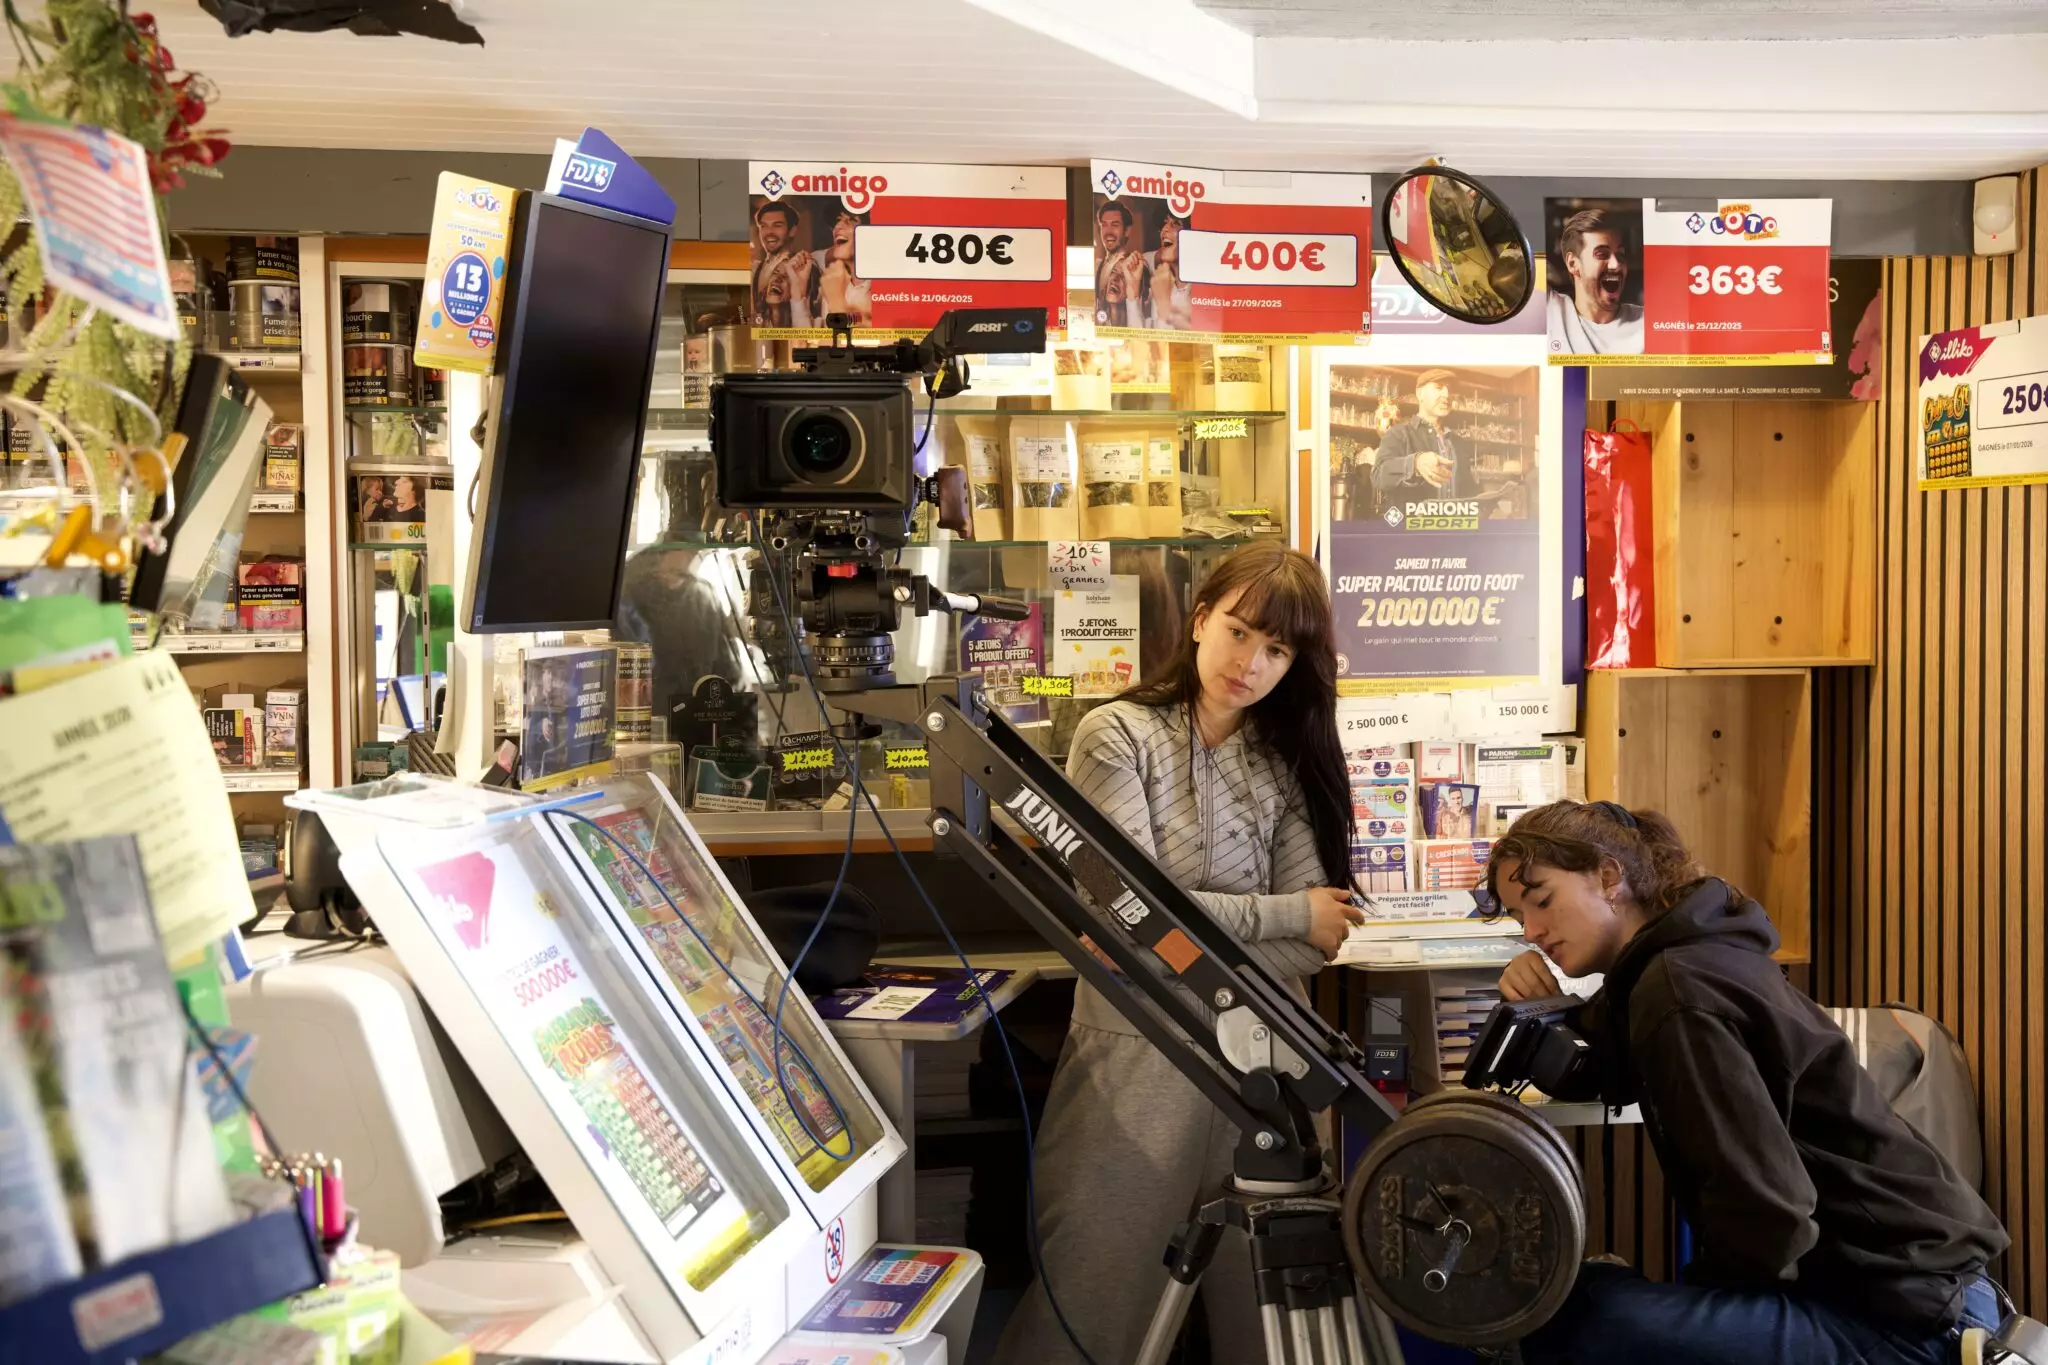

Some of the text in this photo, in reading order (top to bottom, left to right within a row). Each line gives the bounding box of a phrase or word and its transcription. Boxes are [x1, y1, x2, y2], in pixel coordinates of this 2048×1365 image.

[566, 158, 594, 182] FDJ
[791, 167, 888, 209] amigo
[1127, 171, 1205, 213] amigo
[1710, 213, 1777, 234] LOTO
[461, 235, 473, 246] 50
[906, 233, 1014, 265] 480€
[1220, 241, 1326, 272] 400€
[456, 263, 483, 292] 13
[1688, 265, 1784, 295] 363€
[448, 290, 478, 302] MILLIONS
[871, 292, 973, 303] GAGNÉS le 21/06/2025
[1191, 296, 1282, 308] GAGNÉS le 27/09/2025
[346, 313, 372, 322] bouche
[967, 322, 1001, 333] ARRI
[1653, 321, 1742, 330] GAGNÉS le 25/12/2025
[1940, 338, 1973, 361] illiko
[1406, 501, 1479, 516] PARIONS
[1408, 518, 1476, 529] SPORT
[1066, 544, 1103, 560] 10 €
[1394, 558, 1467, 570] SAMEDI 11 AVRIL
[1336, 575, 1382, 593] SUPER
[1384, 575, 1444, 593] PACTOLE
[1446, 575, 1481, 592] LOTO
[1357, 599, 1376, 627] 2
[1376, 597, 1427, 626] 000
[1429, 596, 1480, 625] 000
[1079, 619, 1117, 627] 5 JETONS
[1065, 629, 1102, 637] PRODUIT
[968, 639, 1002, 651] 5 JETONS
[969, 653, 973, 662] 1
[974, 651, 1003, 662] PRODUIT
[1499, 705, 1549, 716] 150 000 €
[1347, 714, 1408, 731] 2 500 000 €
[1006, 783, 1084, 862] JUNI
[557, 1023, 616, 1077] RUBIS
